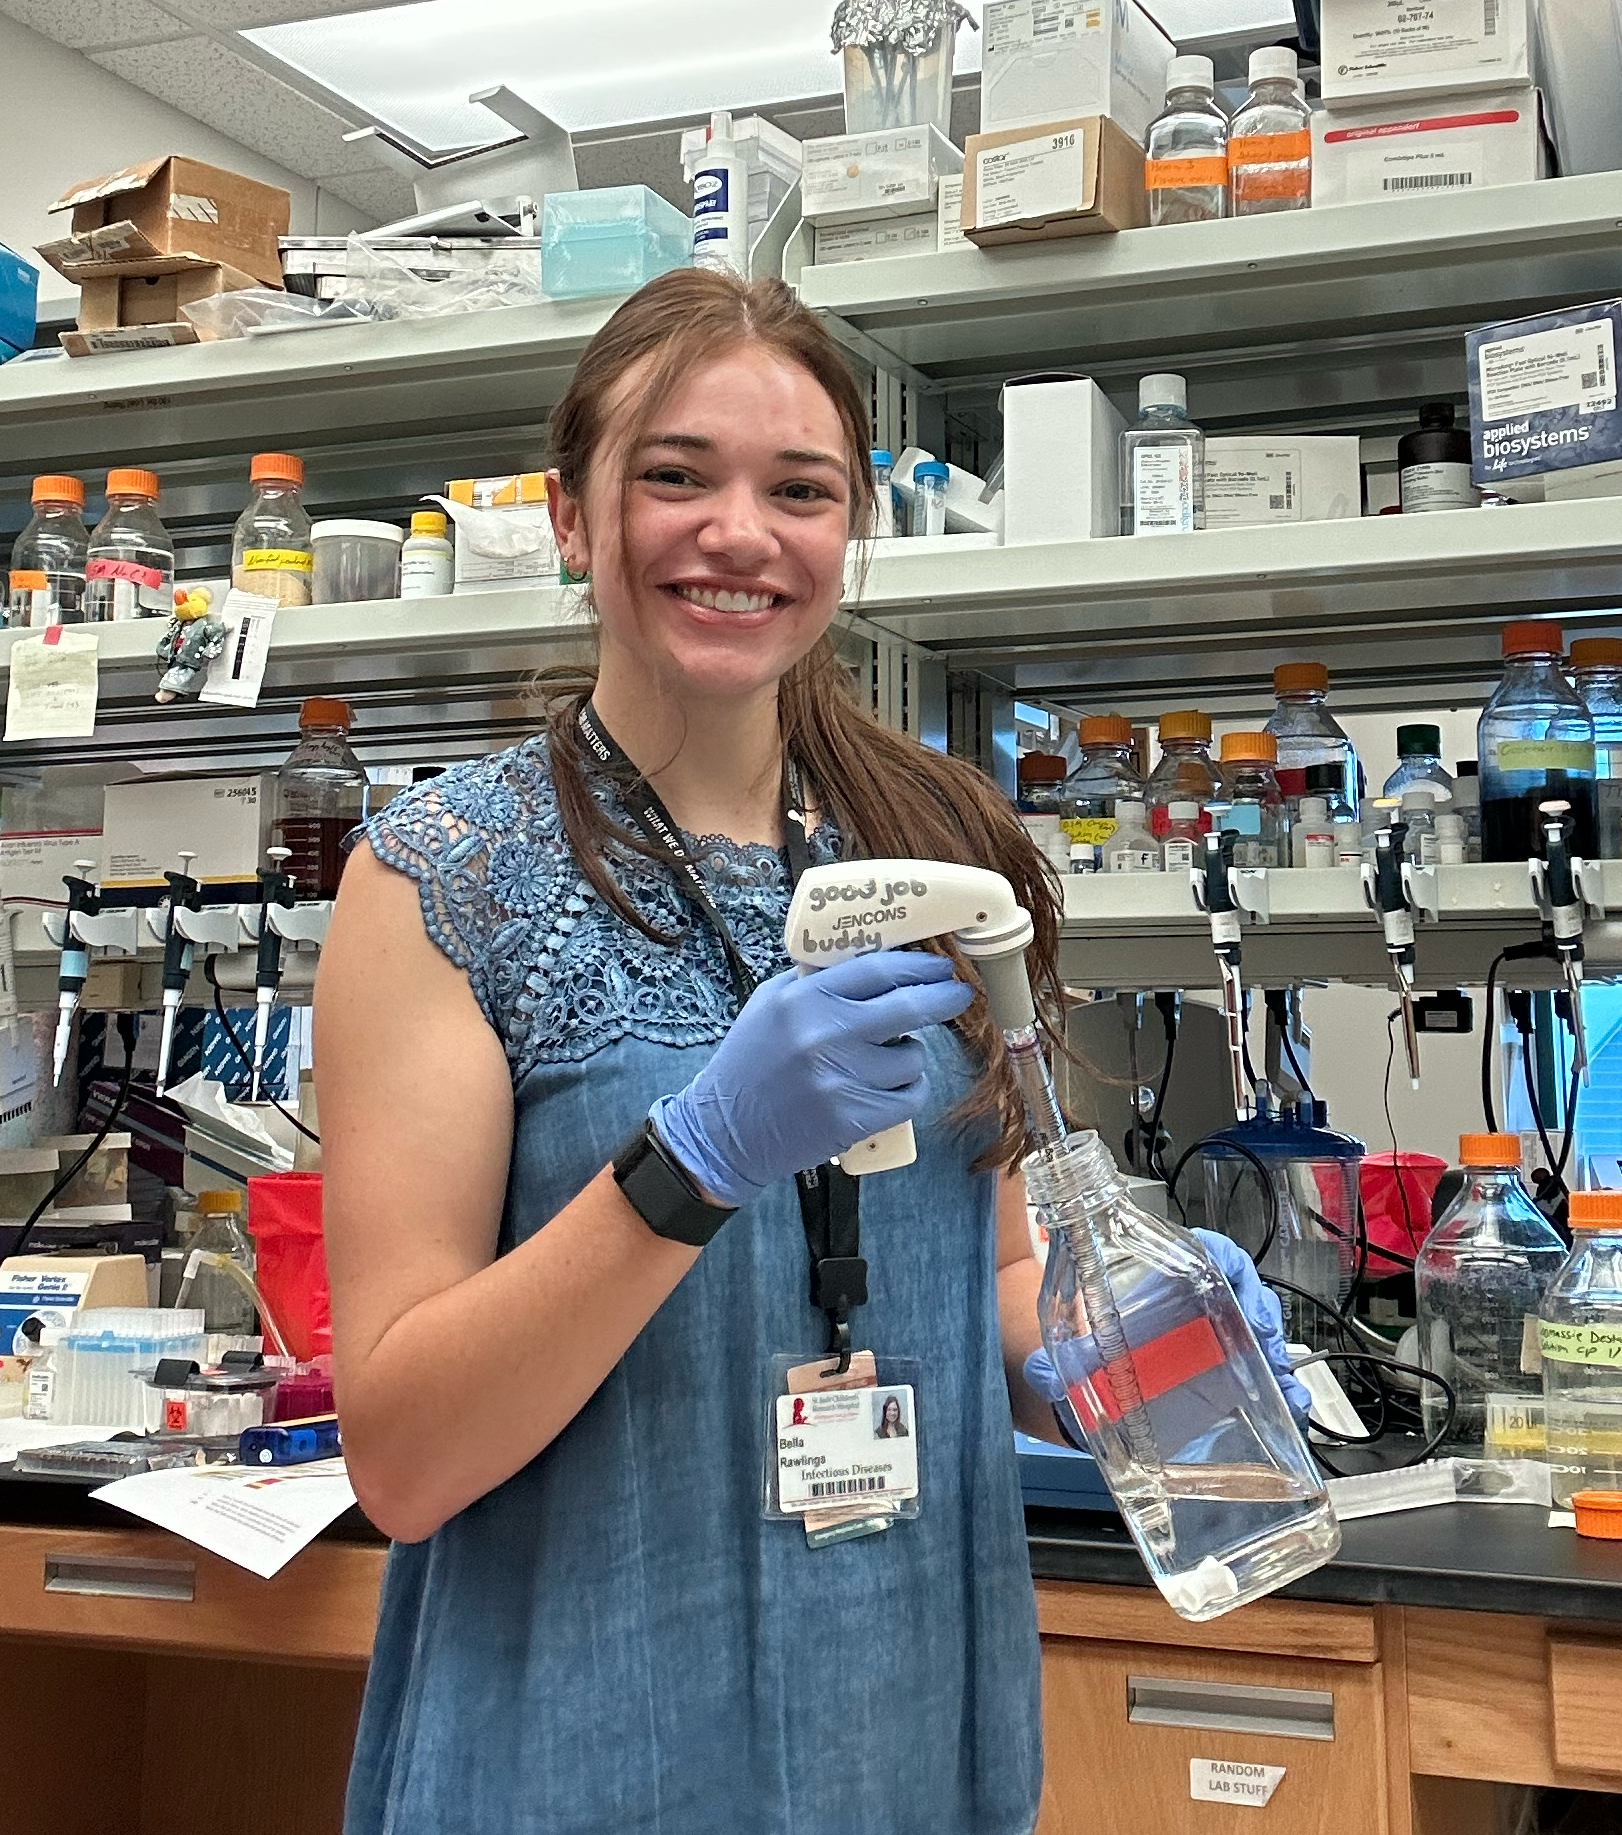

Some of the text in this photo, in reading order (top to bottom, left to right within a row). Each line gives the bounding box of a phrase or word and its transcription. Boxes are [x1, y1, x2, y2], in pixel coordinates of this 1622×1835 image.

[1346, 122, 1420, 138] original eppendorf
[983, 155, 1006, 165] costar
[1483, 419, 1530, 442] applied
[1483, 425, 1590, 459] biosystems
[580, 719, 611, 761] MATTERS
[643, 806, 669, 838] WHAT
[662, 832, 681, 851] WE
[809, 877, 928, 912] good job
[832, 906, 907, 931] JENCONS
[803, 928, 882, 958] buddy
[12, 1274, 67, 1283] Fisher Vortex
[38, 1283, 60, 1291] Genie
[779, 1437, 804, 1450] Bella
[780, 1455, 826, 1468] Rawlings
[801, 1462, 893, 1480] Infectious Diseases
[1210, 1762, 1265, 1778] RANDOM
[1209, 1780, 1268, 1797] LAB STUFF
